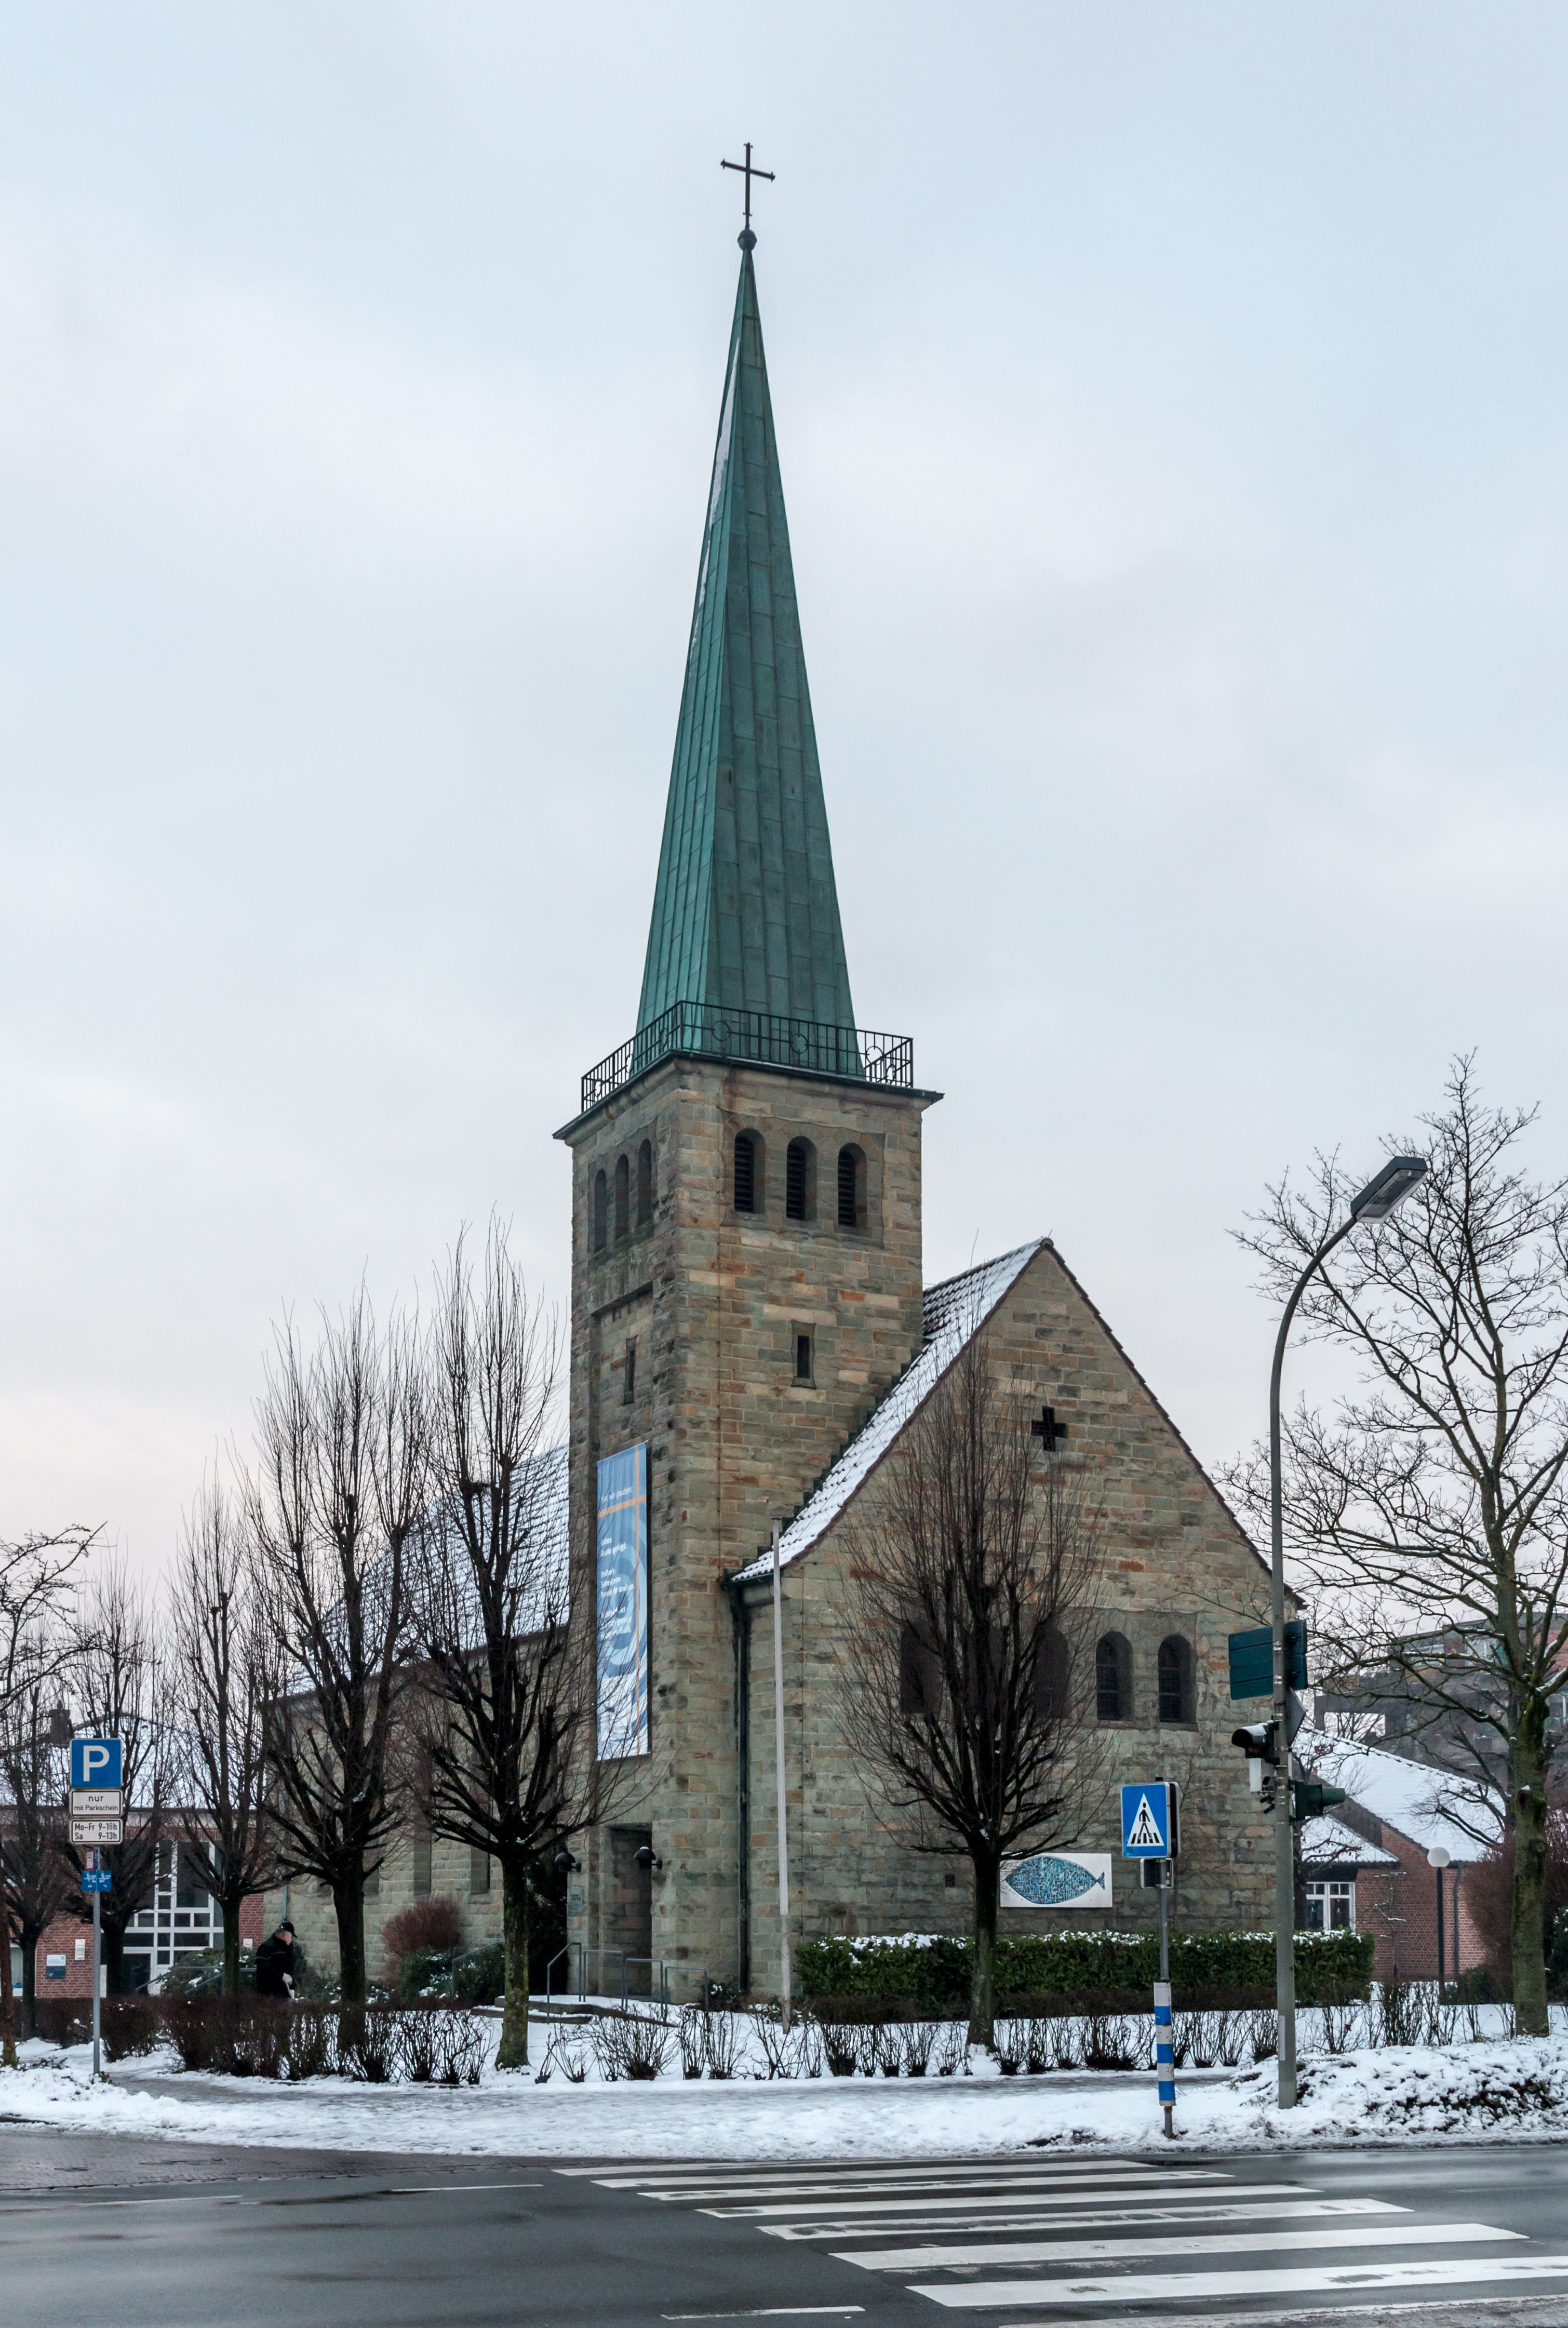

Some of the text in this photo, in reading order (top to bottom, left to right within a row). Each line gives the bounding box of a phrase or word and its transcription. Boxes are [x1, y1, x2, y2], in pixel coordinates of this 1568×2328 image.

[83, 1745, 110, 1782] P
[74, 1823, 117, 1831] Mo-Fr 9-18h
